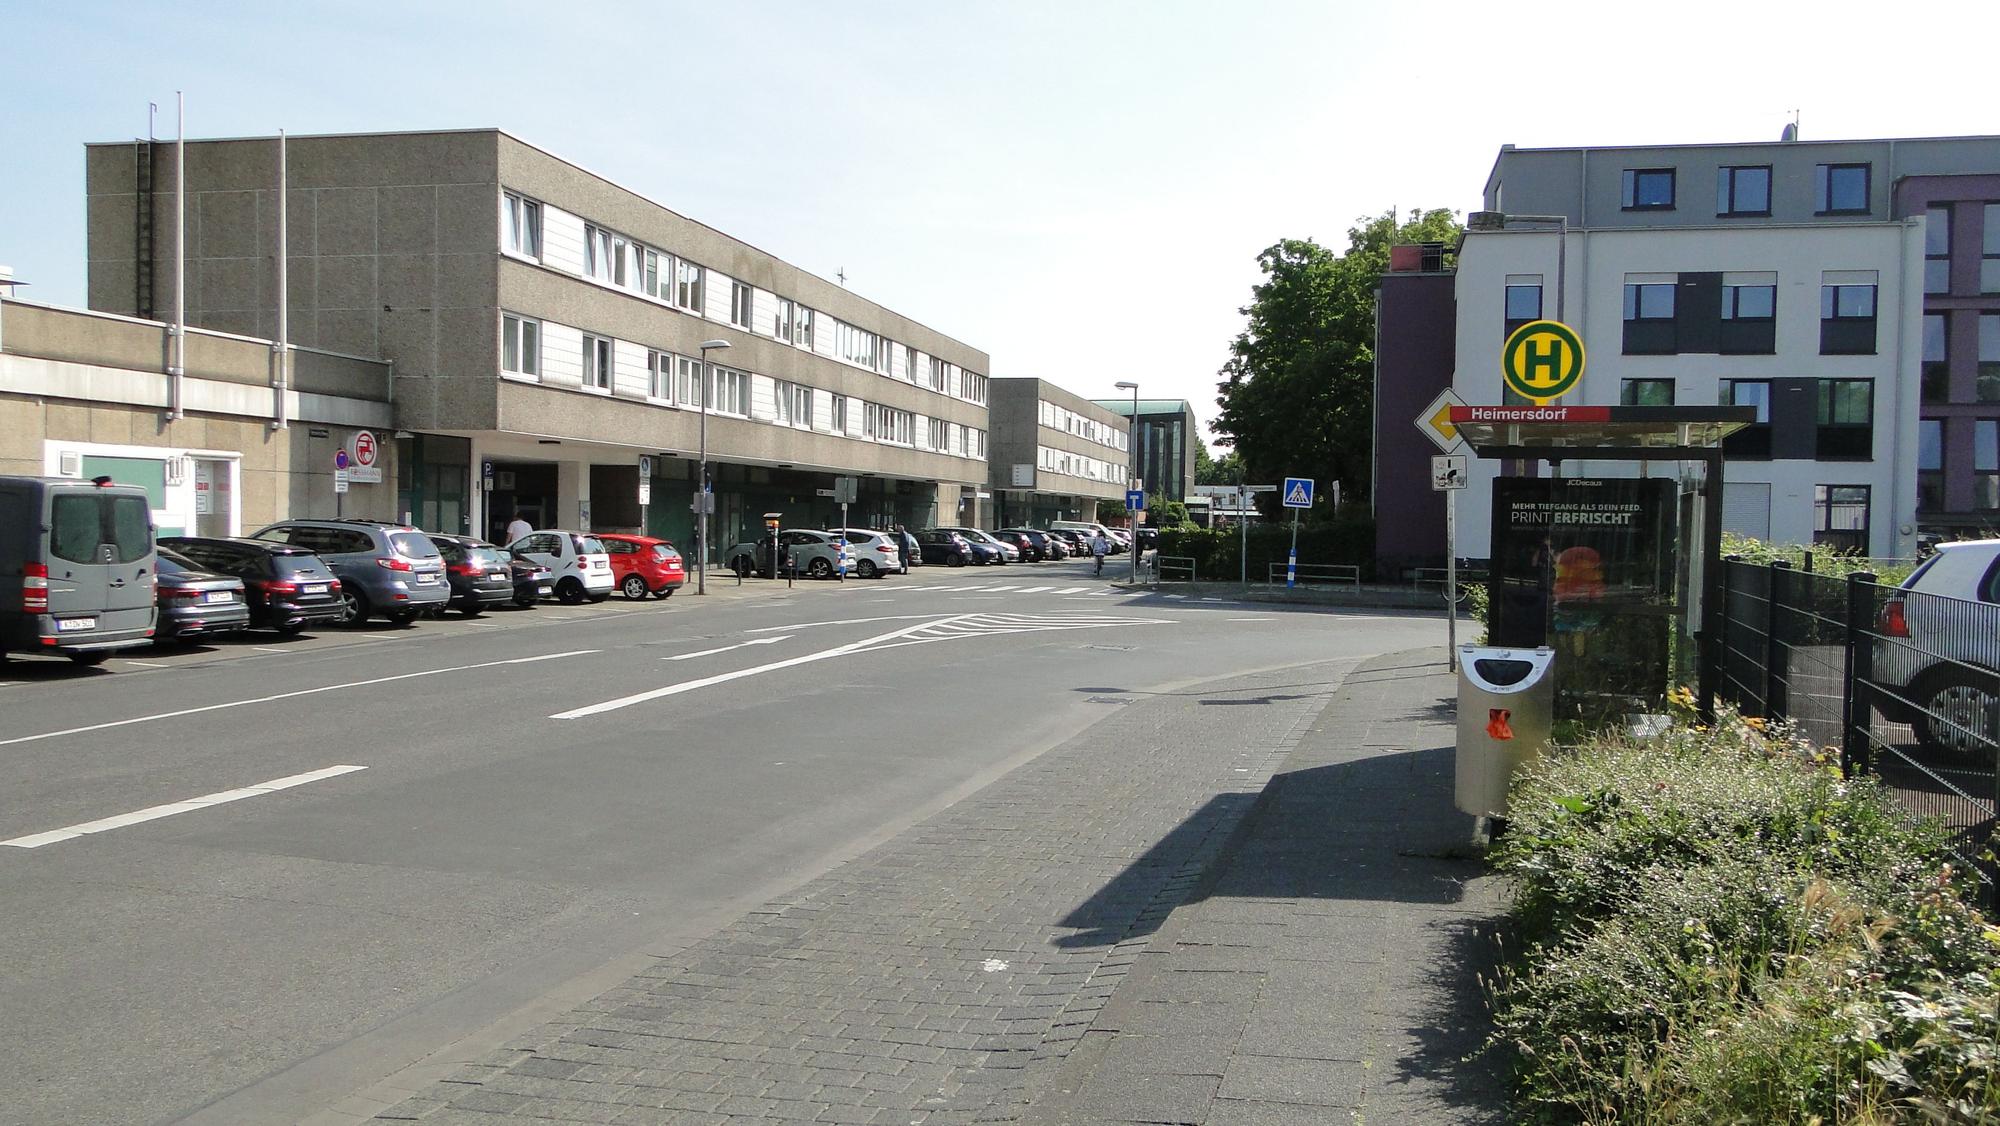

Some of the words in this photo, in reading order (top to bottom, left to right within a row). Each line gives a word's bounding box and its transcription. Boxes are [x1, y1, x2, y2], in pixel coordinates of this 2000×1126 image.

[1524, 340, 1562, 381] H
[1471, 408, 1567, 420] Heimersdorf
[1512, 502, 1536, 510] MEHR
[1511, 511, 1551, 523] PRINT
[1554, 512, 1631, 524] ERFRISCHT
